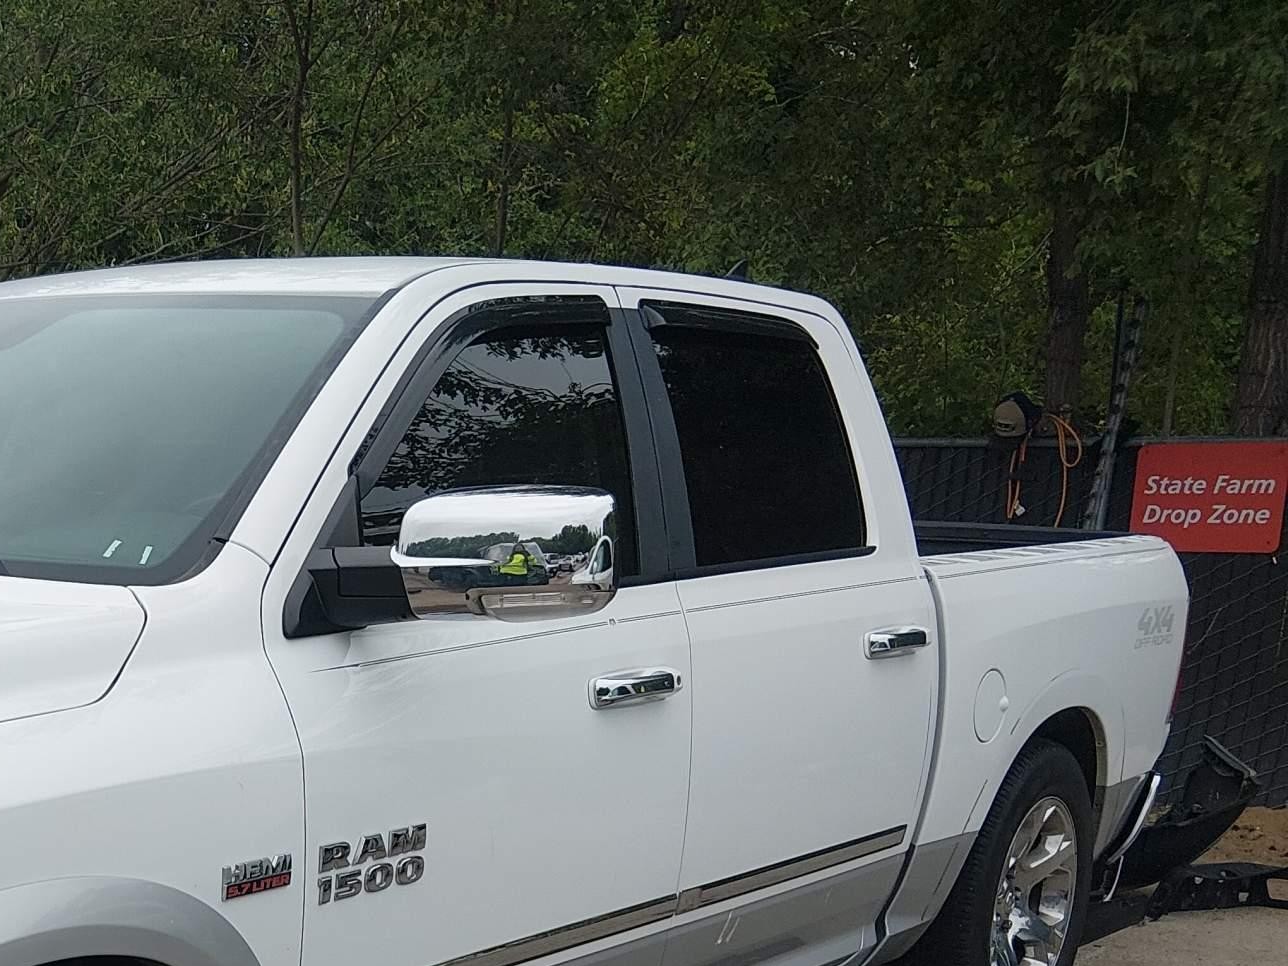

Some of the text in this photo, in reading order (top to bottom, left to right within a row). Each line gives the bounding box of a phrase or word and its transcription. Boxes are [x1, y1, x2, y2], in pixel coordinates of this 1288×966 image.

[1144, 475, 1276, 495] State Farm
[1142, 504, 1271, 529] Drop Zone
[318, 823, 427, 873] RAM
[222, 854, 292, 886] HEMI
[318, 855, 425, 906] 1500
[227, 873, 290, 898] 5.7 LITER
